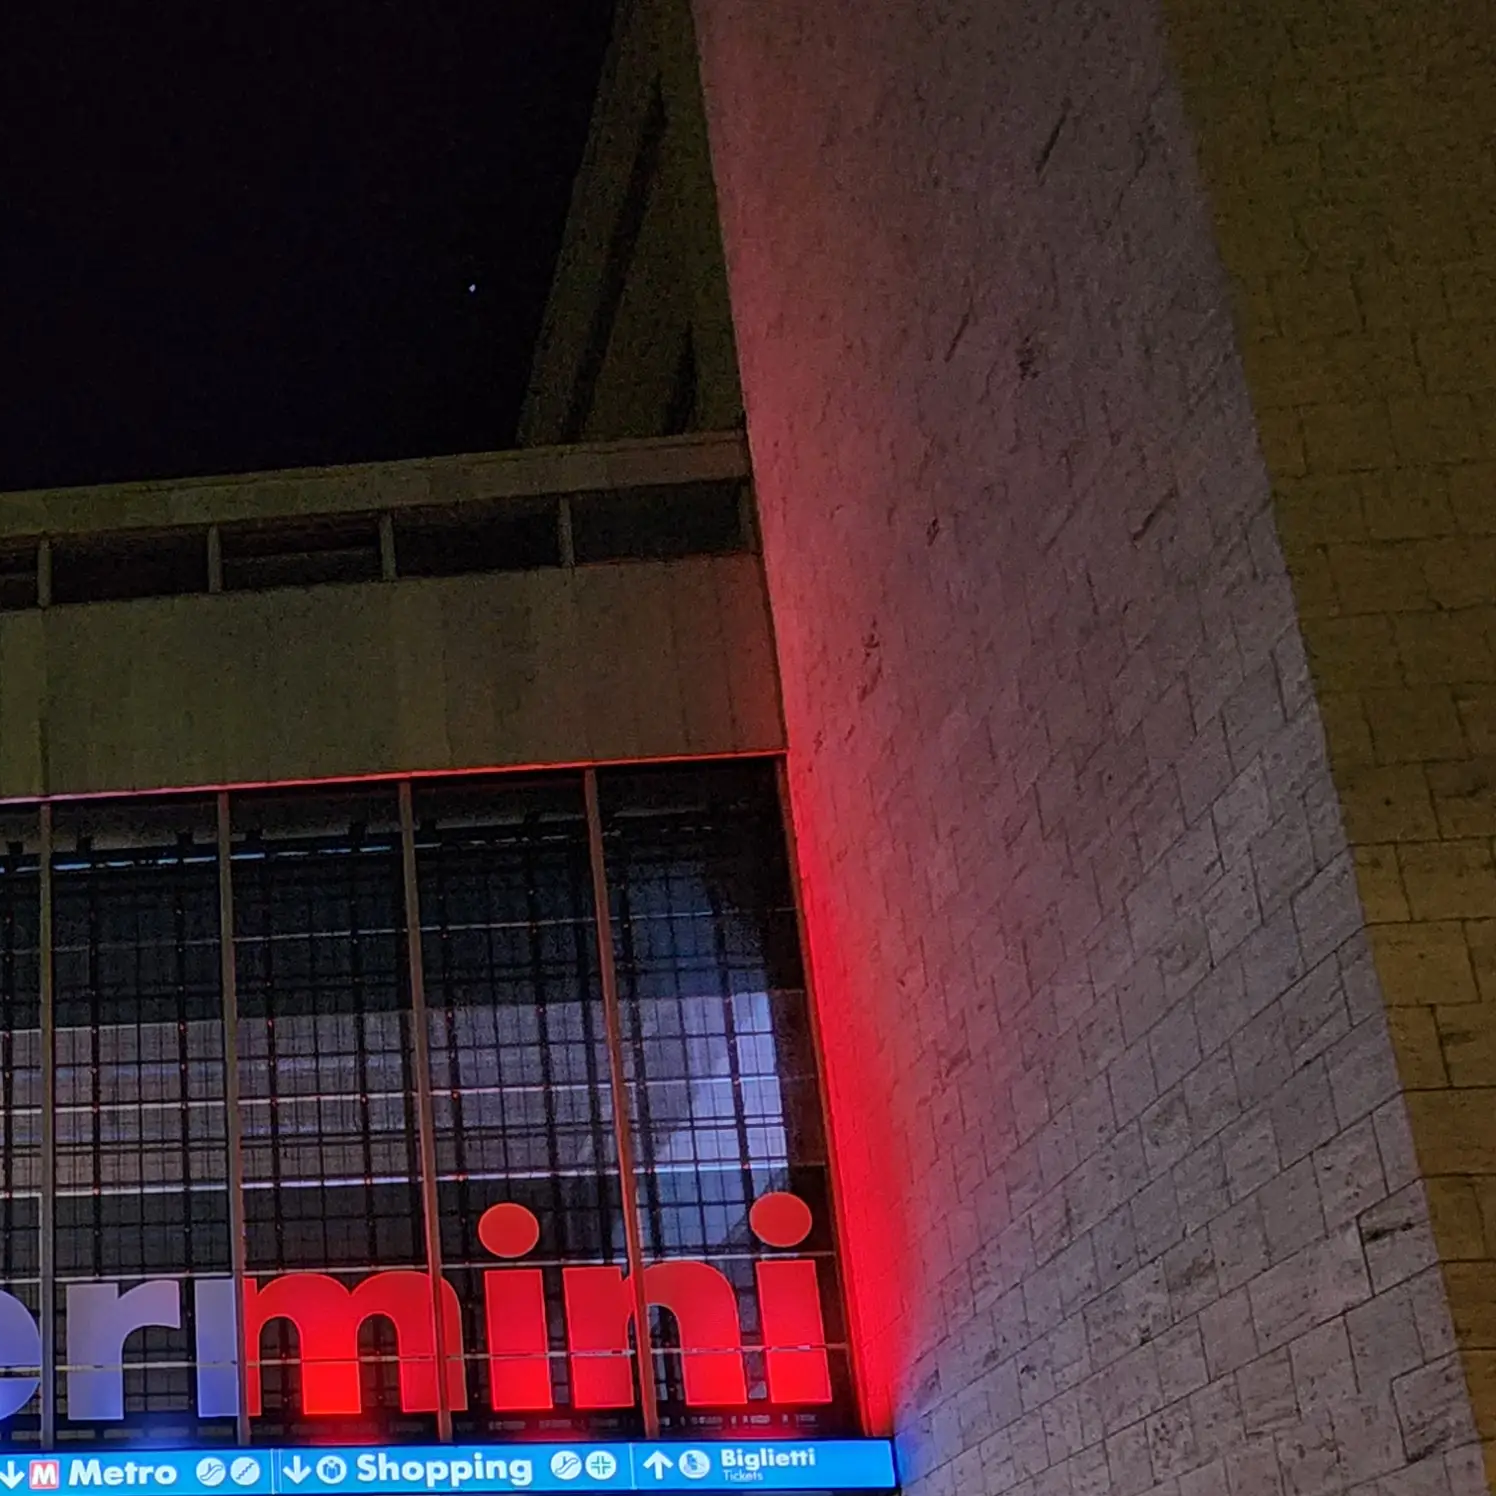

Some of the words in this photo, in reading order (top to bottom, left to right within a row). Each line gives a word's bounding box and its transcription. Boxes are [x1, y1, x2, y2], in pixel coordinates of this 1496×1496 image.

[69, 1458, 179, 1487] Metro
[357, 1452, 534, 1486] Shopping
[720, 1449, 816, 1471] Biglietti
[722, 1468, 763, 1482] Tickets
